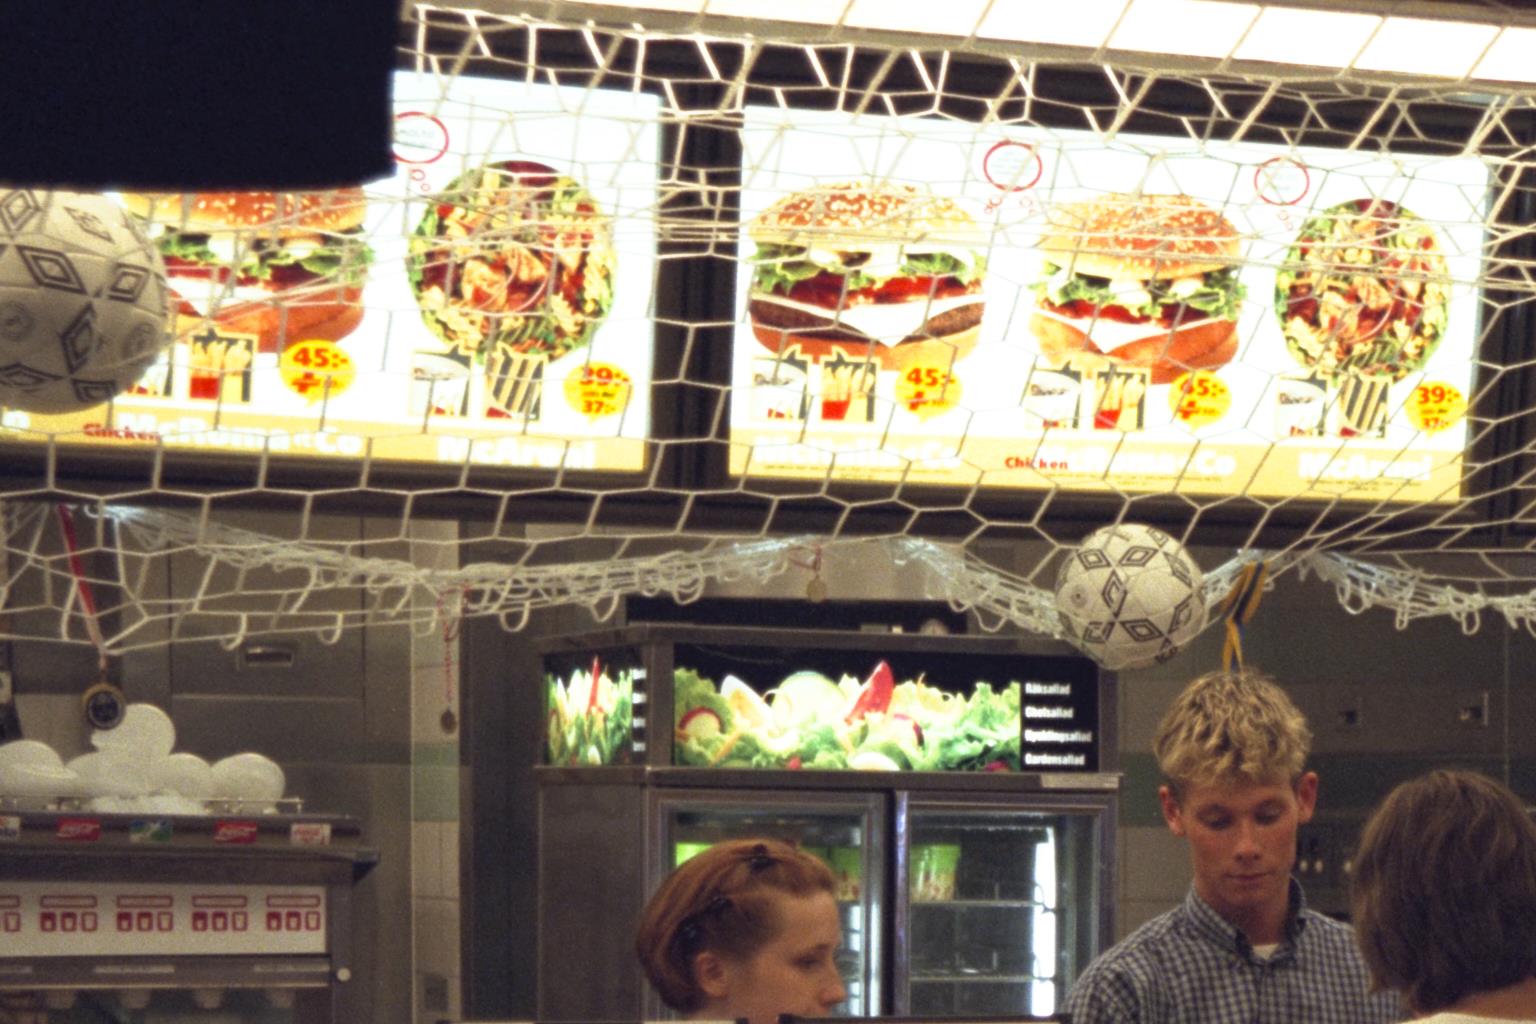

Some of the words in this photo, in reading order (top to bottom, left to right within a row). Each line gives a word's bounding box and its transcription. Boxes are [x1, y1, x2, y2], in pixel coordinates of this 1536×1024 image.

[292, 347, 348, 368] 45:-
[906, 367, 955, 386] 45:-
[1417, 386, 1461, 404] 39:-
